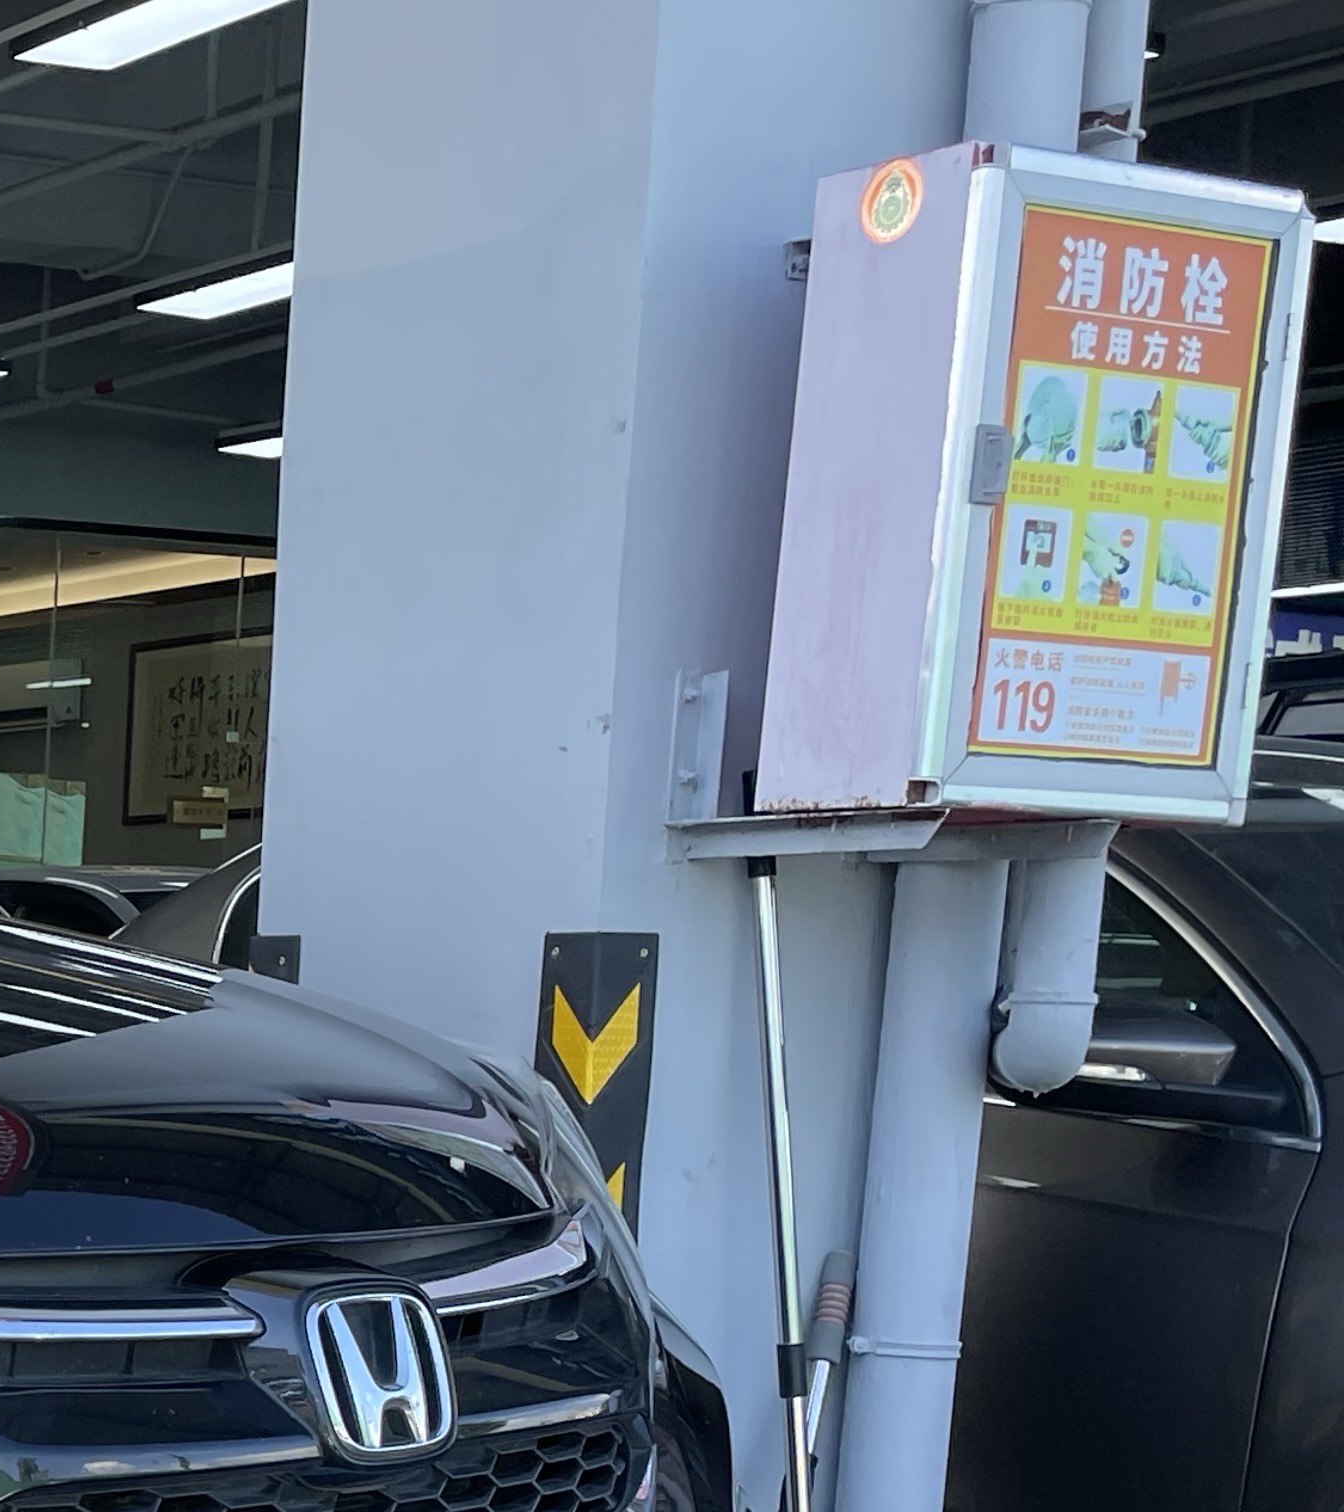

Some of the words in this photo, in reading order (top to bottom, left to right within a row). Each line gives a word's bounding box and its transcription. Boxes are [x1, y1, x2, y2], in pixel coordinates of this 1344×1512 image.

[1057, 236, 1227, 325] 消防栓
[1070, 321, 1202, 374] 使用方法
[993, 648, 1064, 672] 火警电话
[993, 679, 1056, 733] 119
